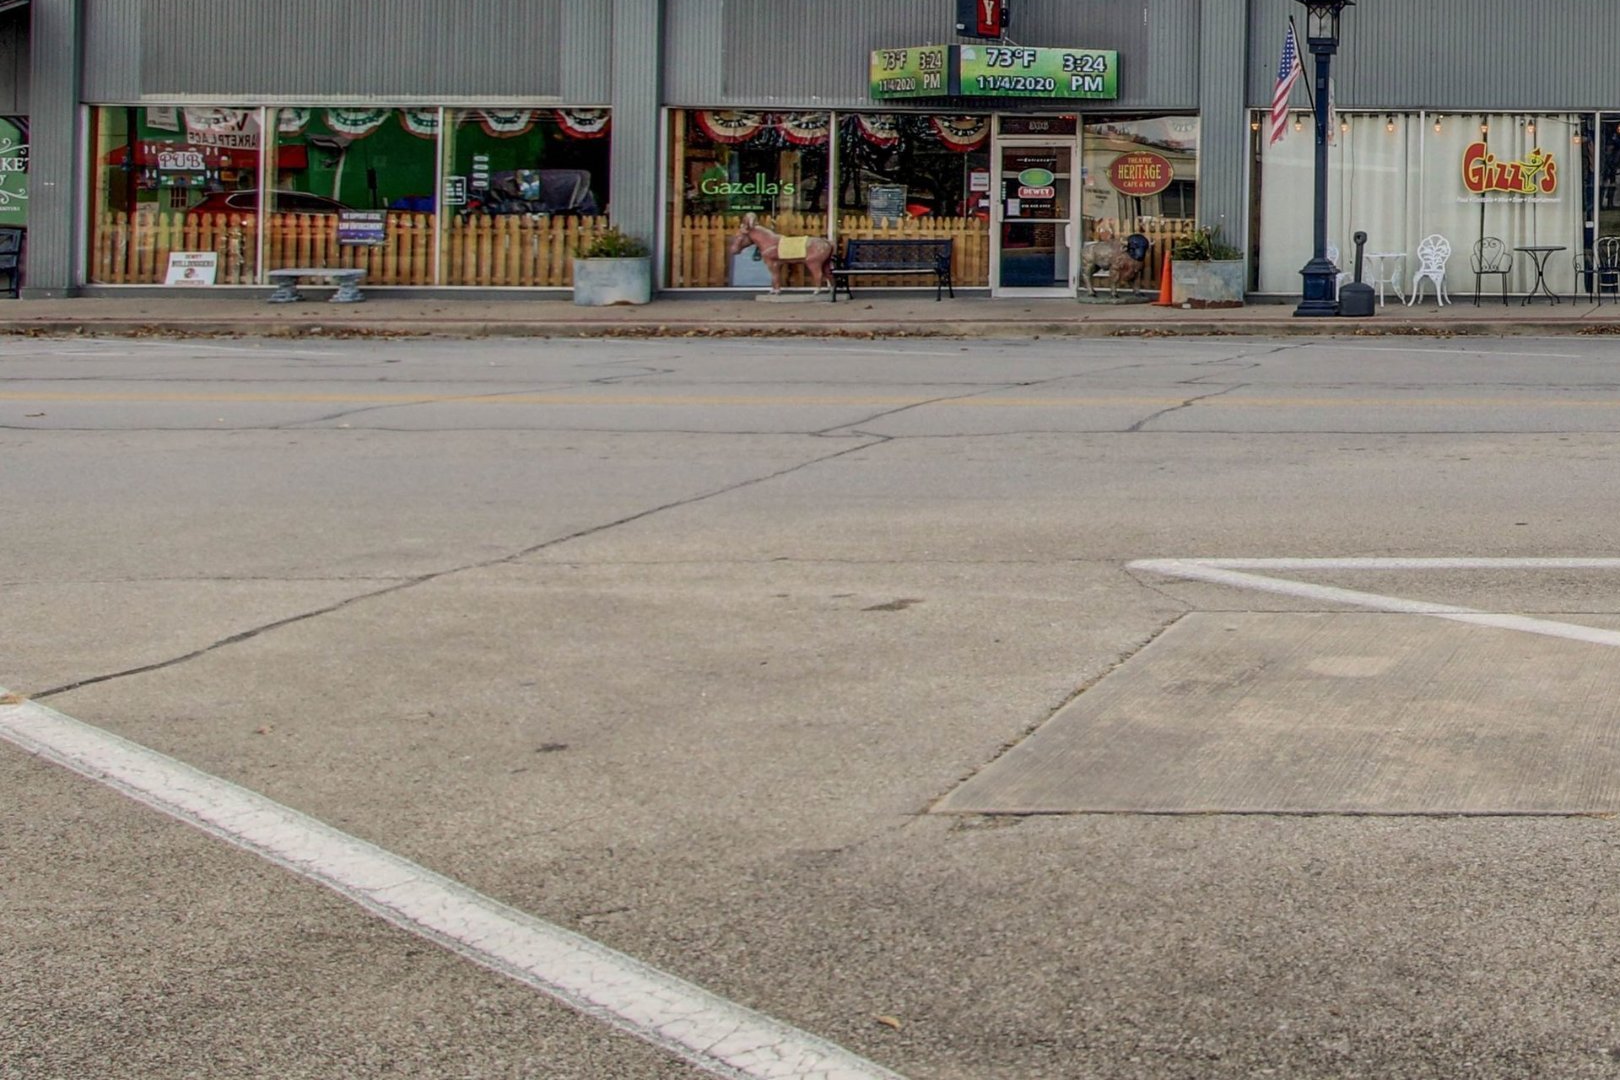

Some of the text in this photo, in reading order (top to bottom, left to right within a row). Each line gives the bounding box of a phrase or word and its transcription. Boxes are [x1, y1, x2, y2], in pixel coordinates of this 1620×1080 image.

[882, 50, 943, 70] 73°F 3:24
[986, 48, 1105, 72] 73°F 3:24
[878, 77, 916, 92] 11/4/2020
[922, 72, 941, 89] PM
[976, 75, 1055, 91] 11/4/2020
[1071, 75, 1103, 91] PM
[0, 158, 30, 171] KE
[160, 153, 201, 168] PUB
[1118, 164, 1162, 180] HERITAGE
[701, 172, 795, 195] Gazella's
